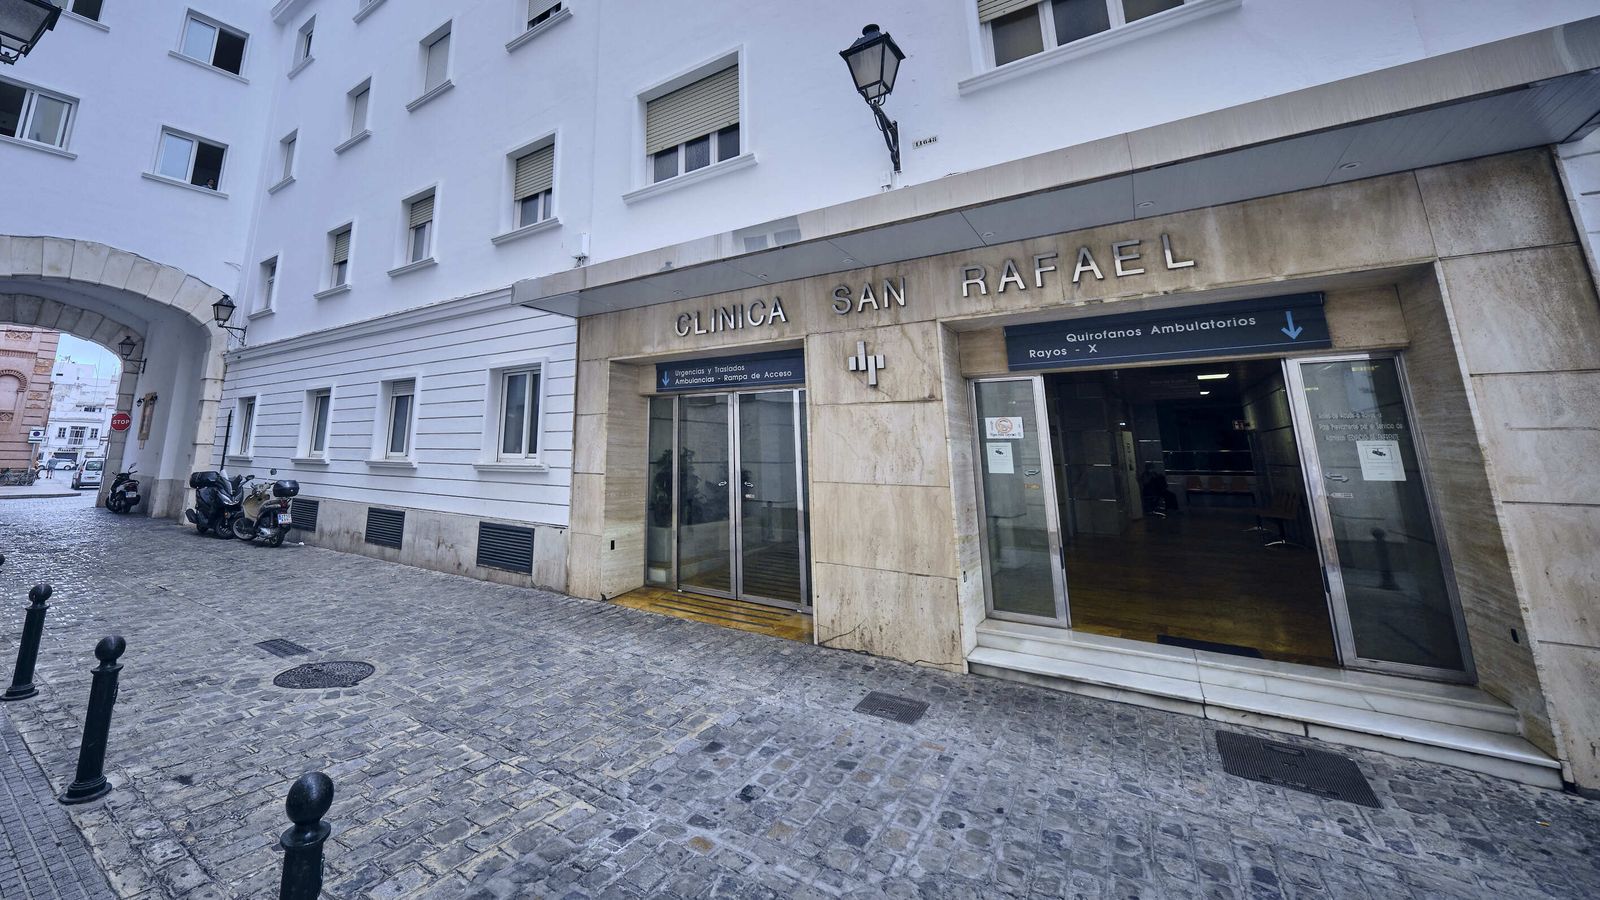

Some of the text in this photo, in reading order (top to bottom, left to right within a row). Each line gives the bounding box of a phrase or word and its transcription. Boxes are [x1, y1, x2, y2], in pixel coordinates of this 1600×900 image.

[675, 233, 1195, 337] CLINICA SAN RAFAEL
[1066, 315, 1257, 343] Quirofanos Ambulatorios
[1029, 347, 1067, 359] Rayos
[1088, 344, 1098, 353] X
[675, 367, 705, 377] Urgencias
[714, 364, 745, 374] Traslados
[675, 375, 715, 385] Ambulancias
[724, 373, 748, 382] Rampa
[764, 369, 792, 378] Acceso
